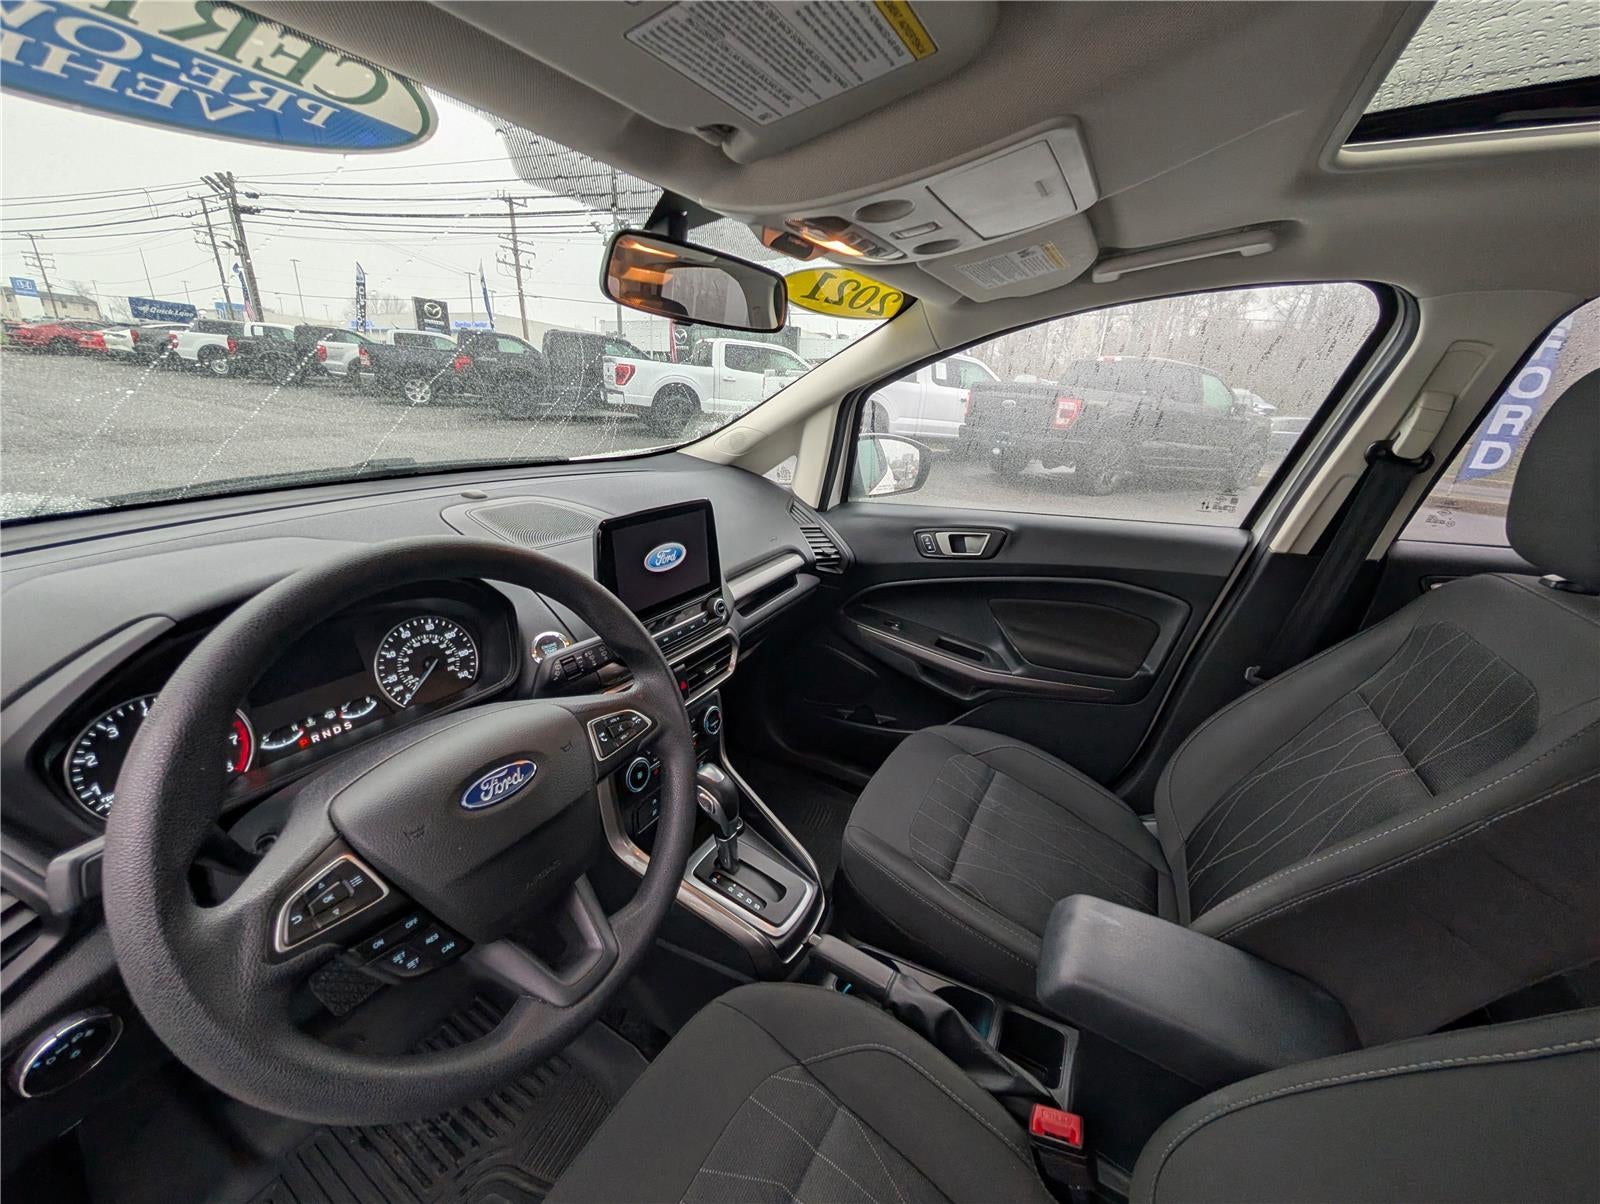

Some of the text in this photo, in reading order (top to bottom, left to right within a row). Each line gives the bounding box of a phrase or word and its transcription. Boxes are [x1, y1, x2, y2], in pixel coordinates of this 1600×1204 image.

[150, 306, 174, 316] Quick
[655, 549, 677, 566] Ford
[106, 726, 119, 738] 3
[311, 734, 320, 743] R
[322, 730, 331, 738] N
[333, 726, 342, 734] D
[344, 721, 353, 730] S
[85, 754, 98, 767] 2
[91, 784, 101, 795] 1
[480, 766, 525, 801] Ford
[322, 893, 335, 904] OK
[405, 917, 418, 929] OFF
[372, 938, 385, 949] ON
[441, 941, 455, 954] CAN
